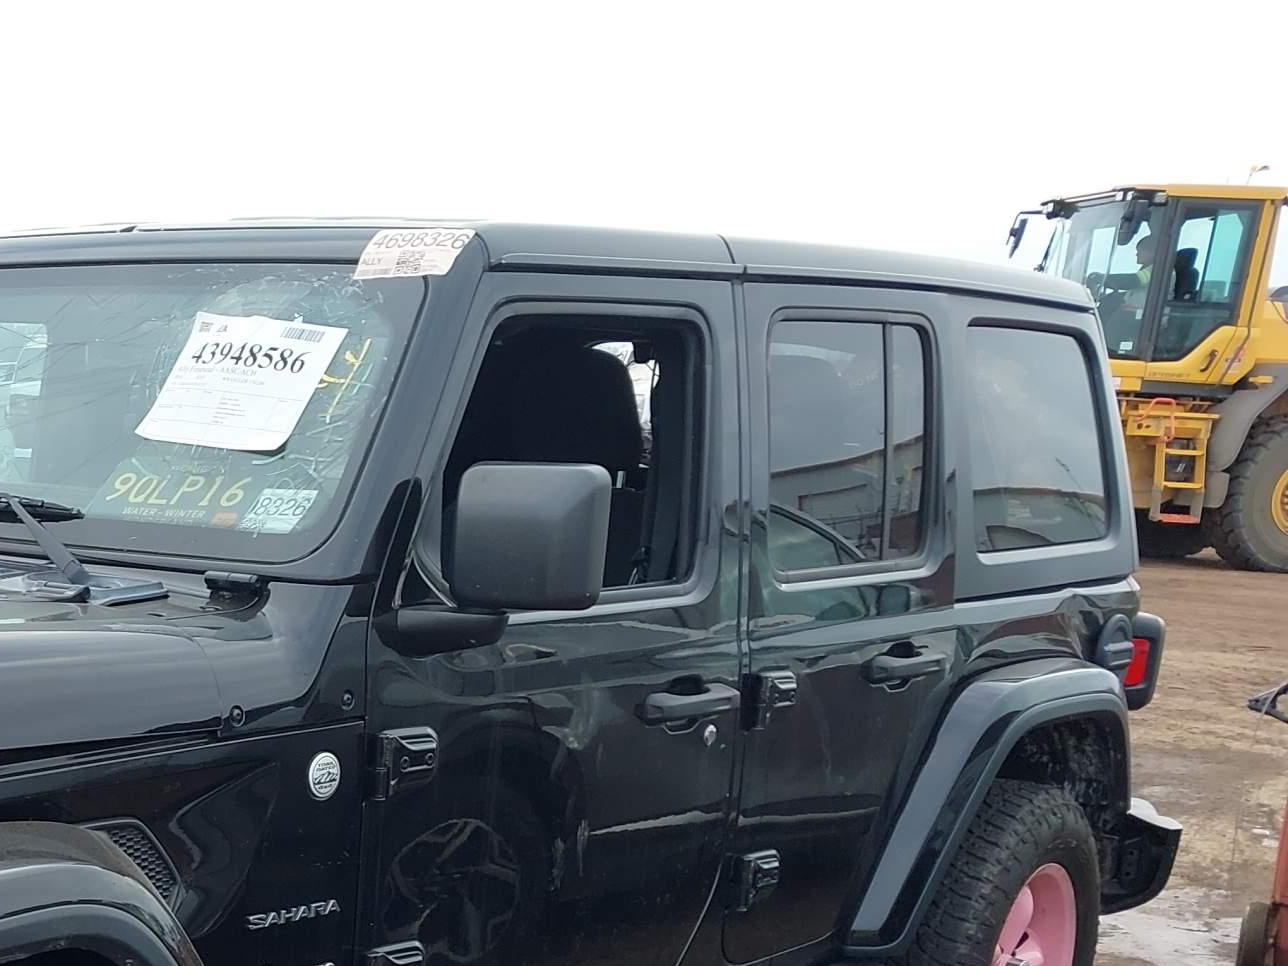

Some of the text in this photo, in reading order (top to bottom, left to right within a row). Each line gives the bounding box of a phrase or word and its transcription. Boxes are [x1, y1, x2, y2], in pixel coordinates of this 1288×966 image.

[372, 231, 470, 250] 4698326
[361, 256, 383, 266] ALLY
[192, 341, 312, 374] 43948586
[247, 899, 341, 930] SAHARA
